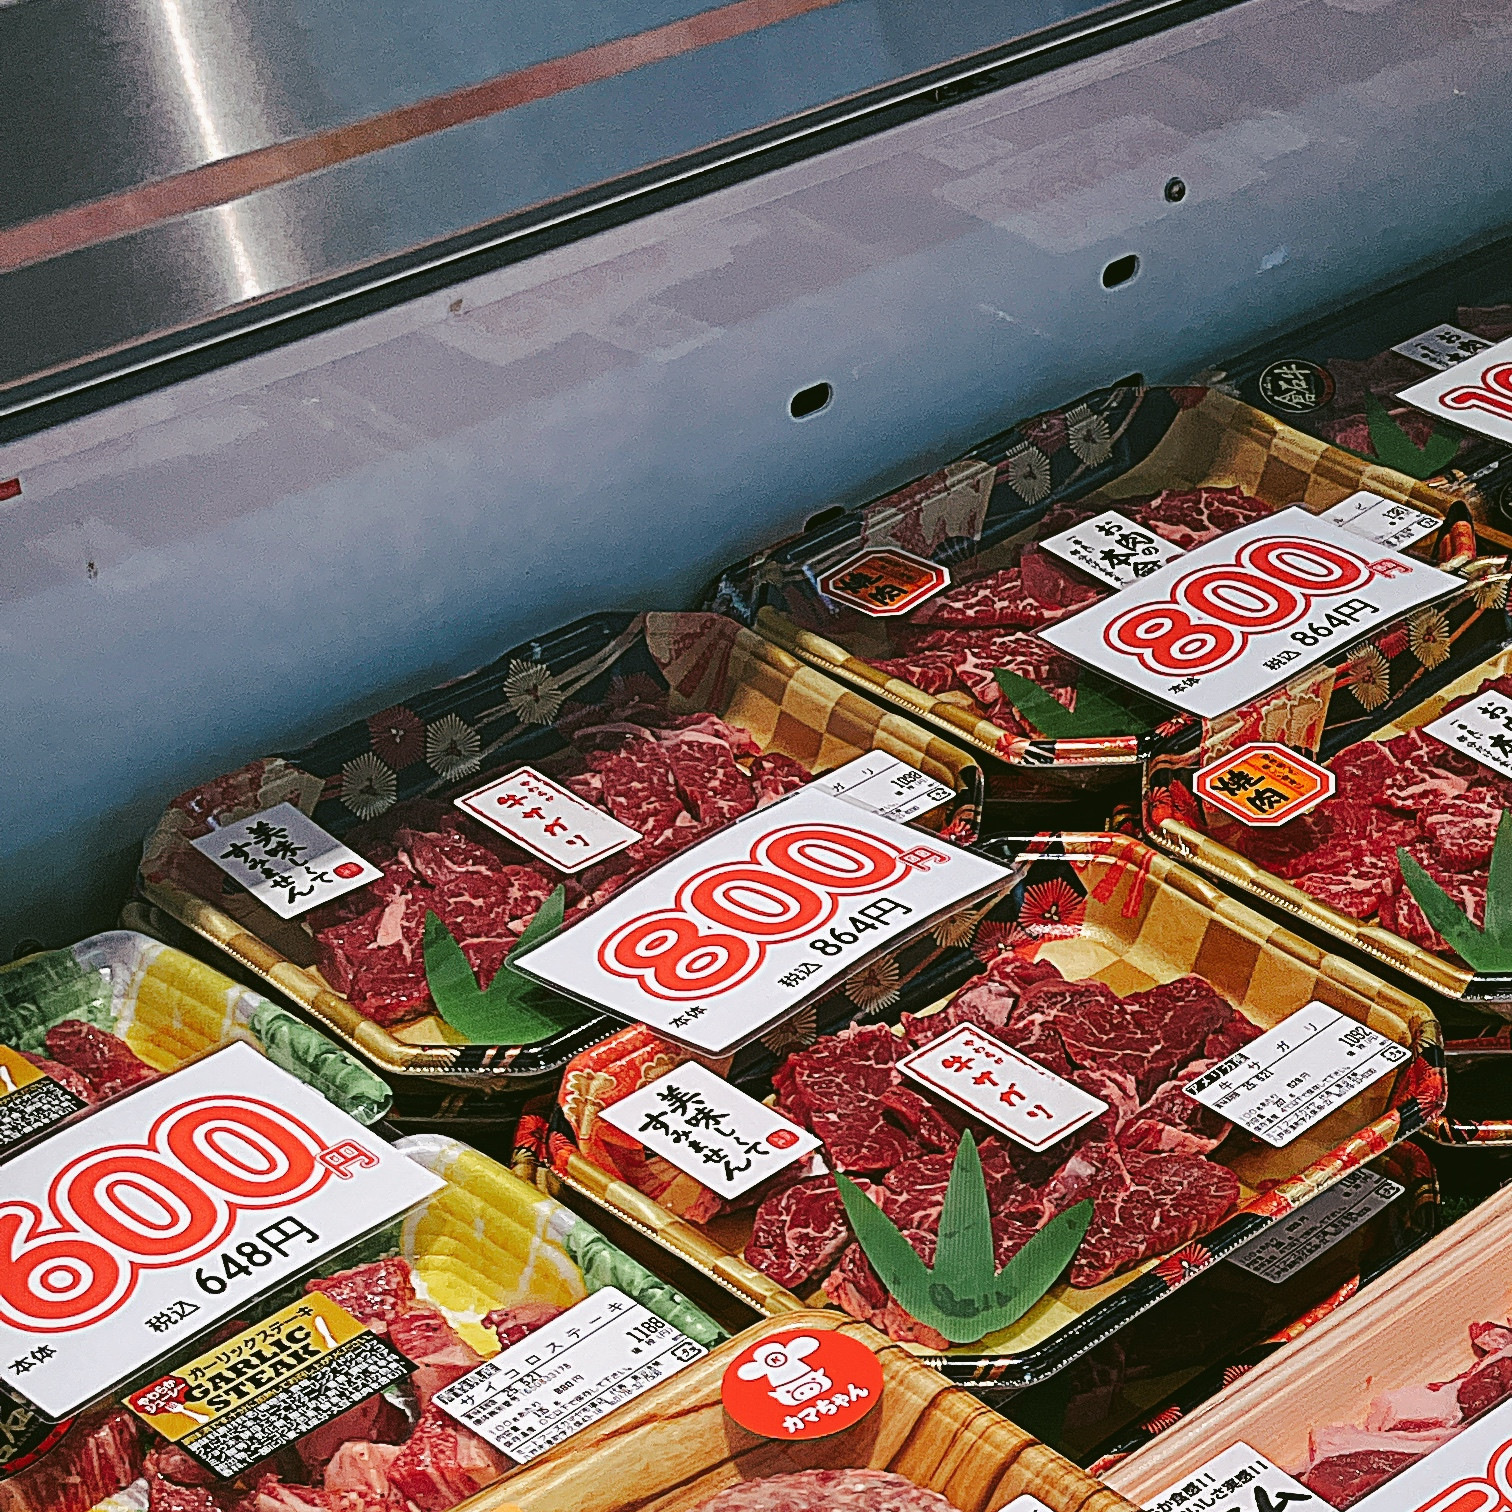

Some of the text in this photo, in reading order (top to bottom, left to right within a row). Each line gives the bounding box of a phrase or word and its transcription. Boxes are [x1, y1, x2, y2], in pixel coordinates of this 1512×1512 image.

[1263, 598, 1380, 673] 税込 864円
[1168, 676, 1201, 696] 本体
[777, 897, 913, 991] 税込 864円
[668, 1004, 708, 1030] 本体
[144, 1215, 321, 1333] 税込 648円
[8, 1344, 58, 1377] 本体
[183, 1325, 313, 1406] GARLIC
[188, 1304, 315, 1384] ガーリックステーキ
[459, 1298, 625, 1407] サイコロステーキ
[629, 1315, 668, 1344] 1188
[213, 1343, 326, 1414] STEAK
[782, 1383, 871, 1434] カマちゃん
